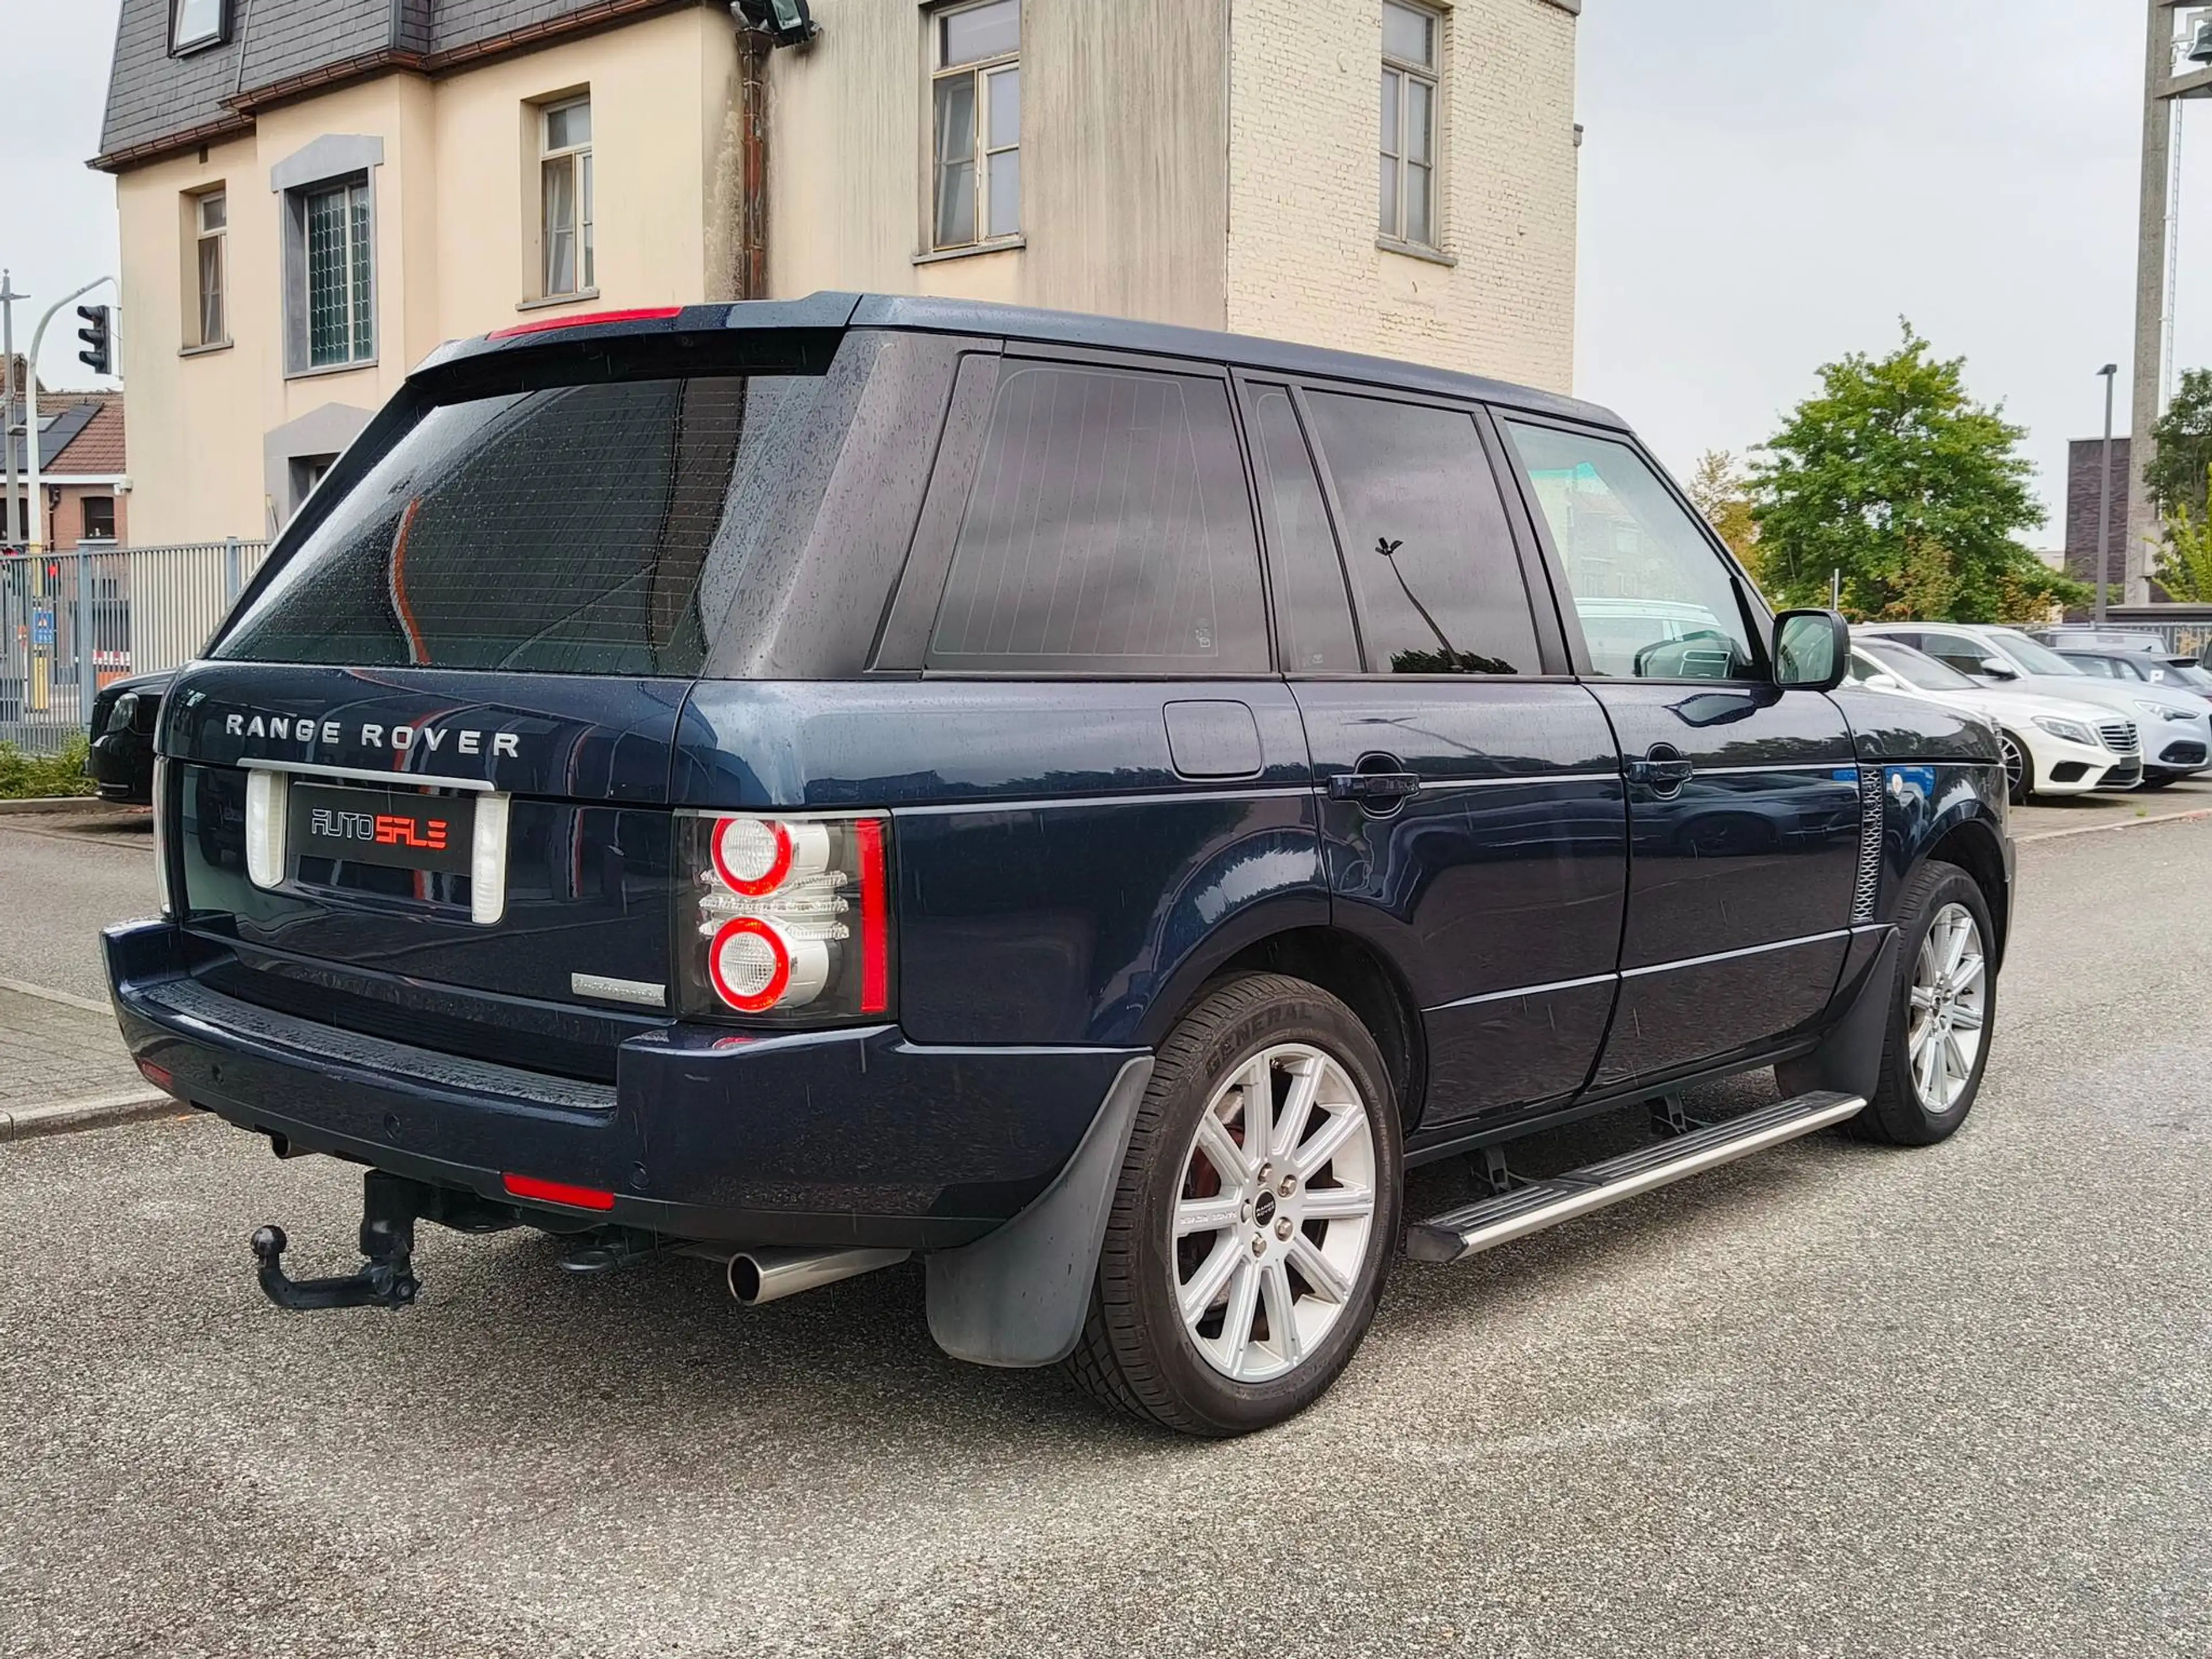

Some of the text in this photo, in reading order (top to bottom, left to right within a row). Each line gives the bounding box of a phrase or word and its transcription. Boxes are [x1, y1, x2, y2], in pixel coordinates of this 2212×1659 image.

[226, 714, 518, 758] RANGE ROVER
[312, 808, 448, 849] AUTOSALE
[1206, 1002, 1312, 1078] GENERAL
